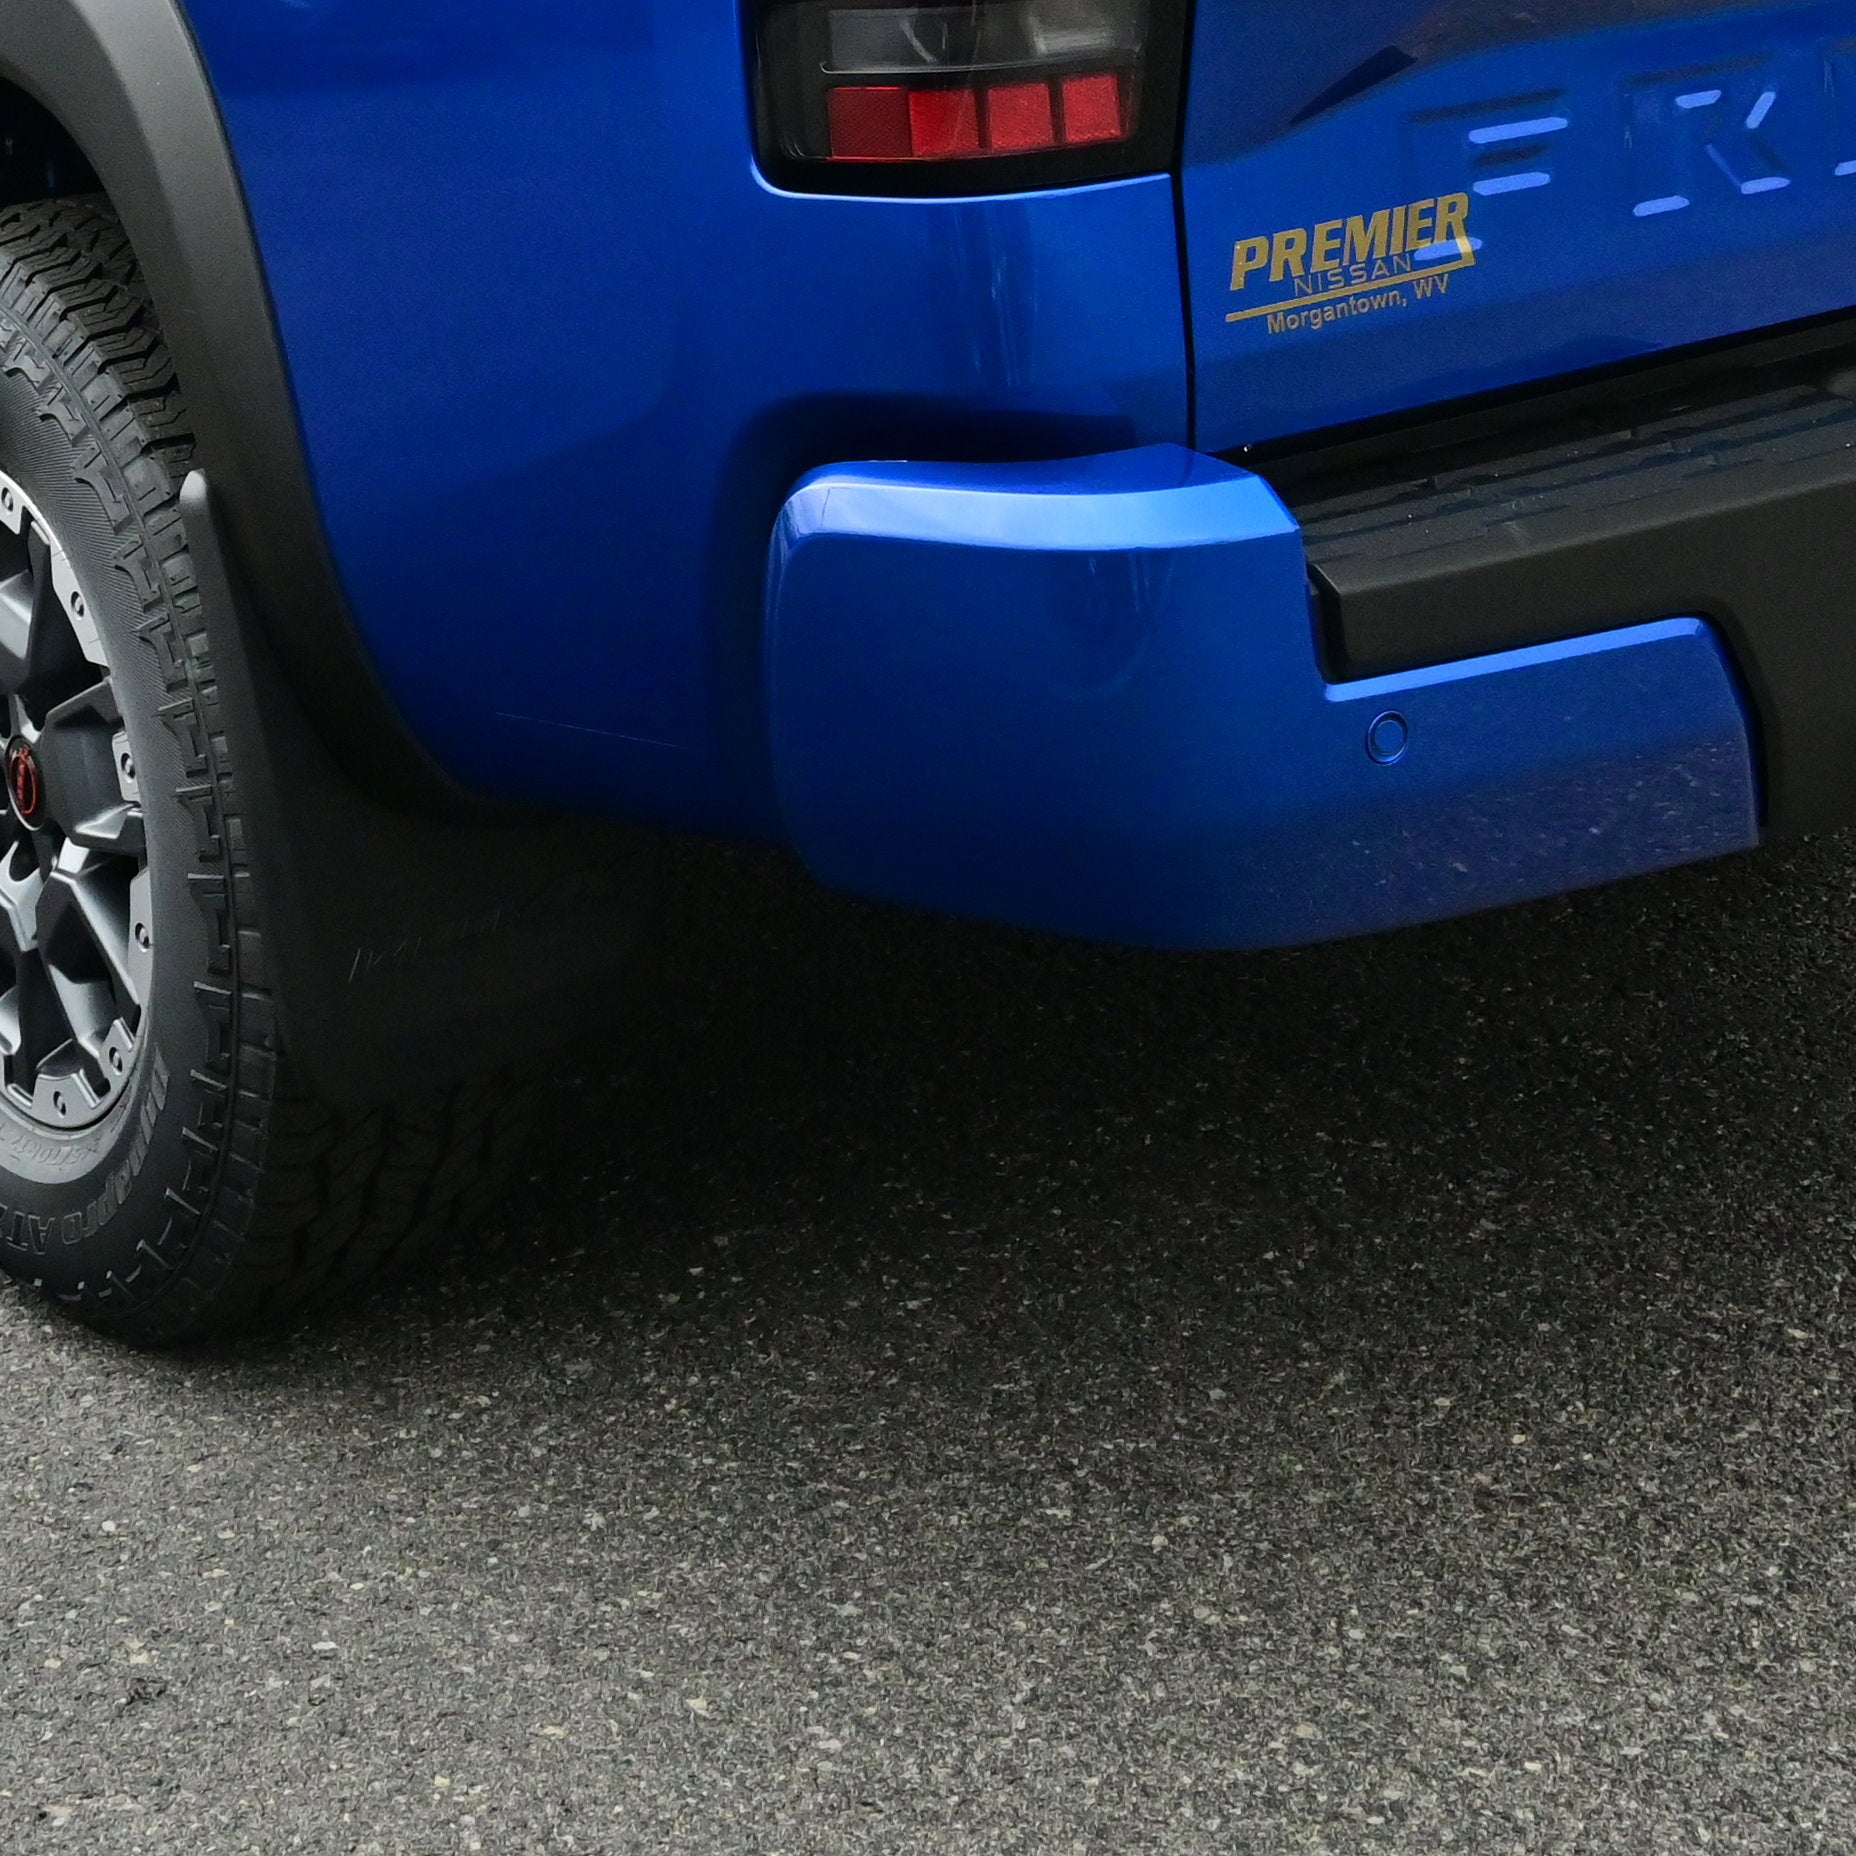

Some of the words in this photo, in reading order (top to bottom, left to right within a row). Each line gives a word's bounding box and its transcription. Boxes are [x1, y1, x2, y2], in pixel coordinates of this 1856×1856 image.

[1229, 192, 1477, 291] PREMIER
[1266, 290, 1408, 335] Morgantown,
[1411, 273, 1451, 300] WV
[1294, 252, 1413, 296] NISSAN
